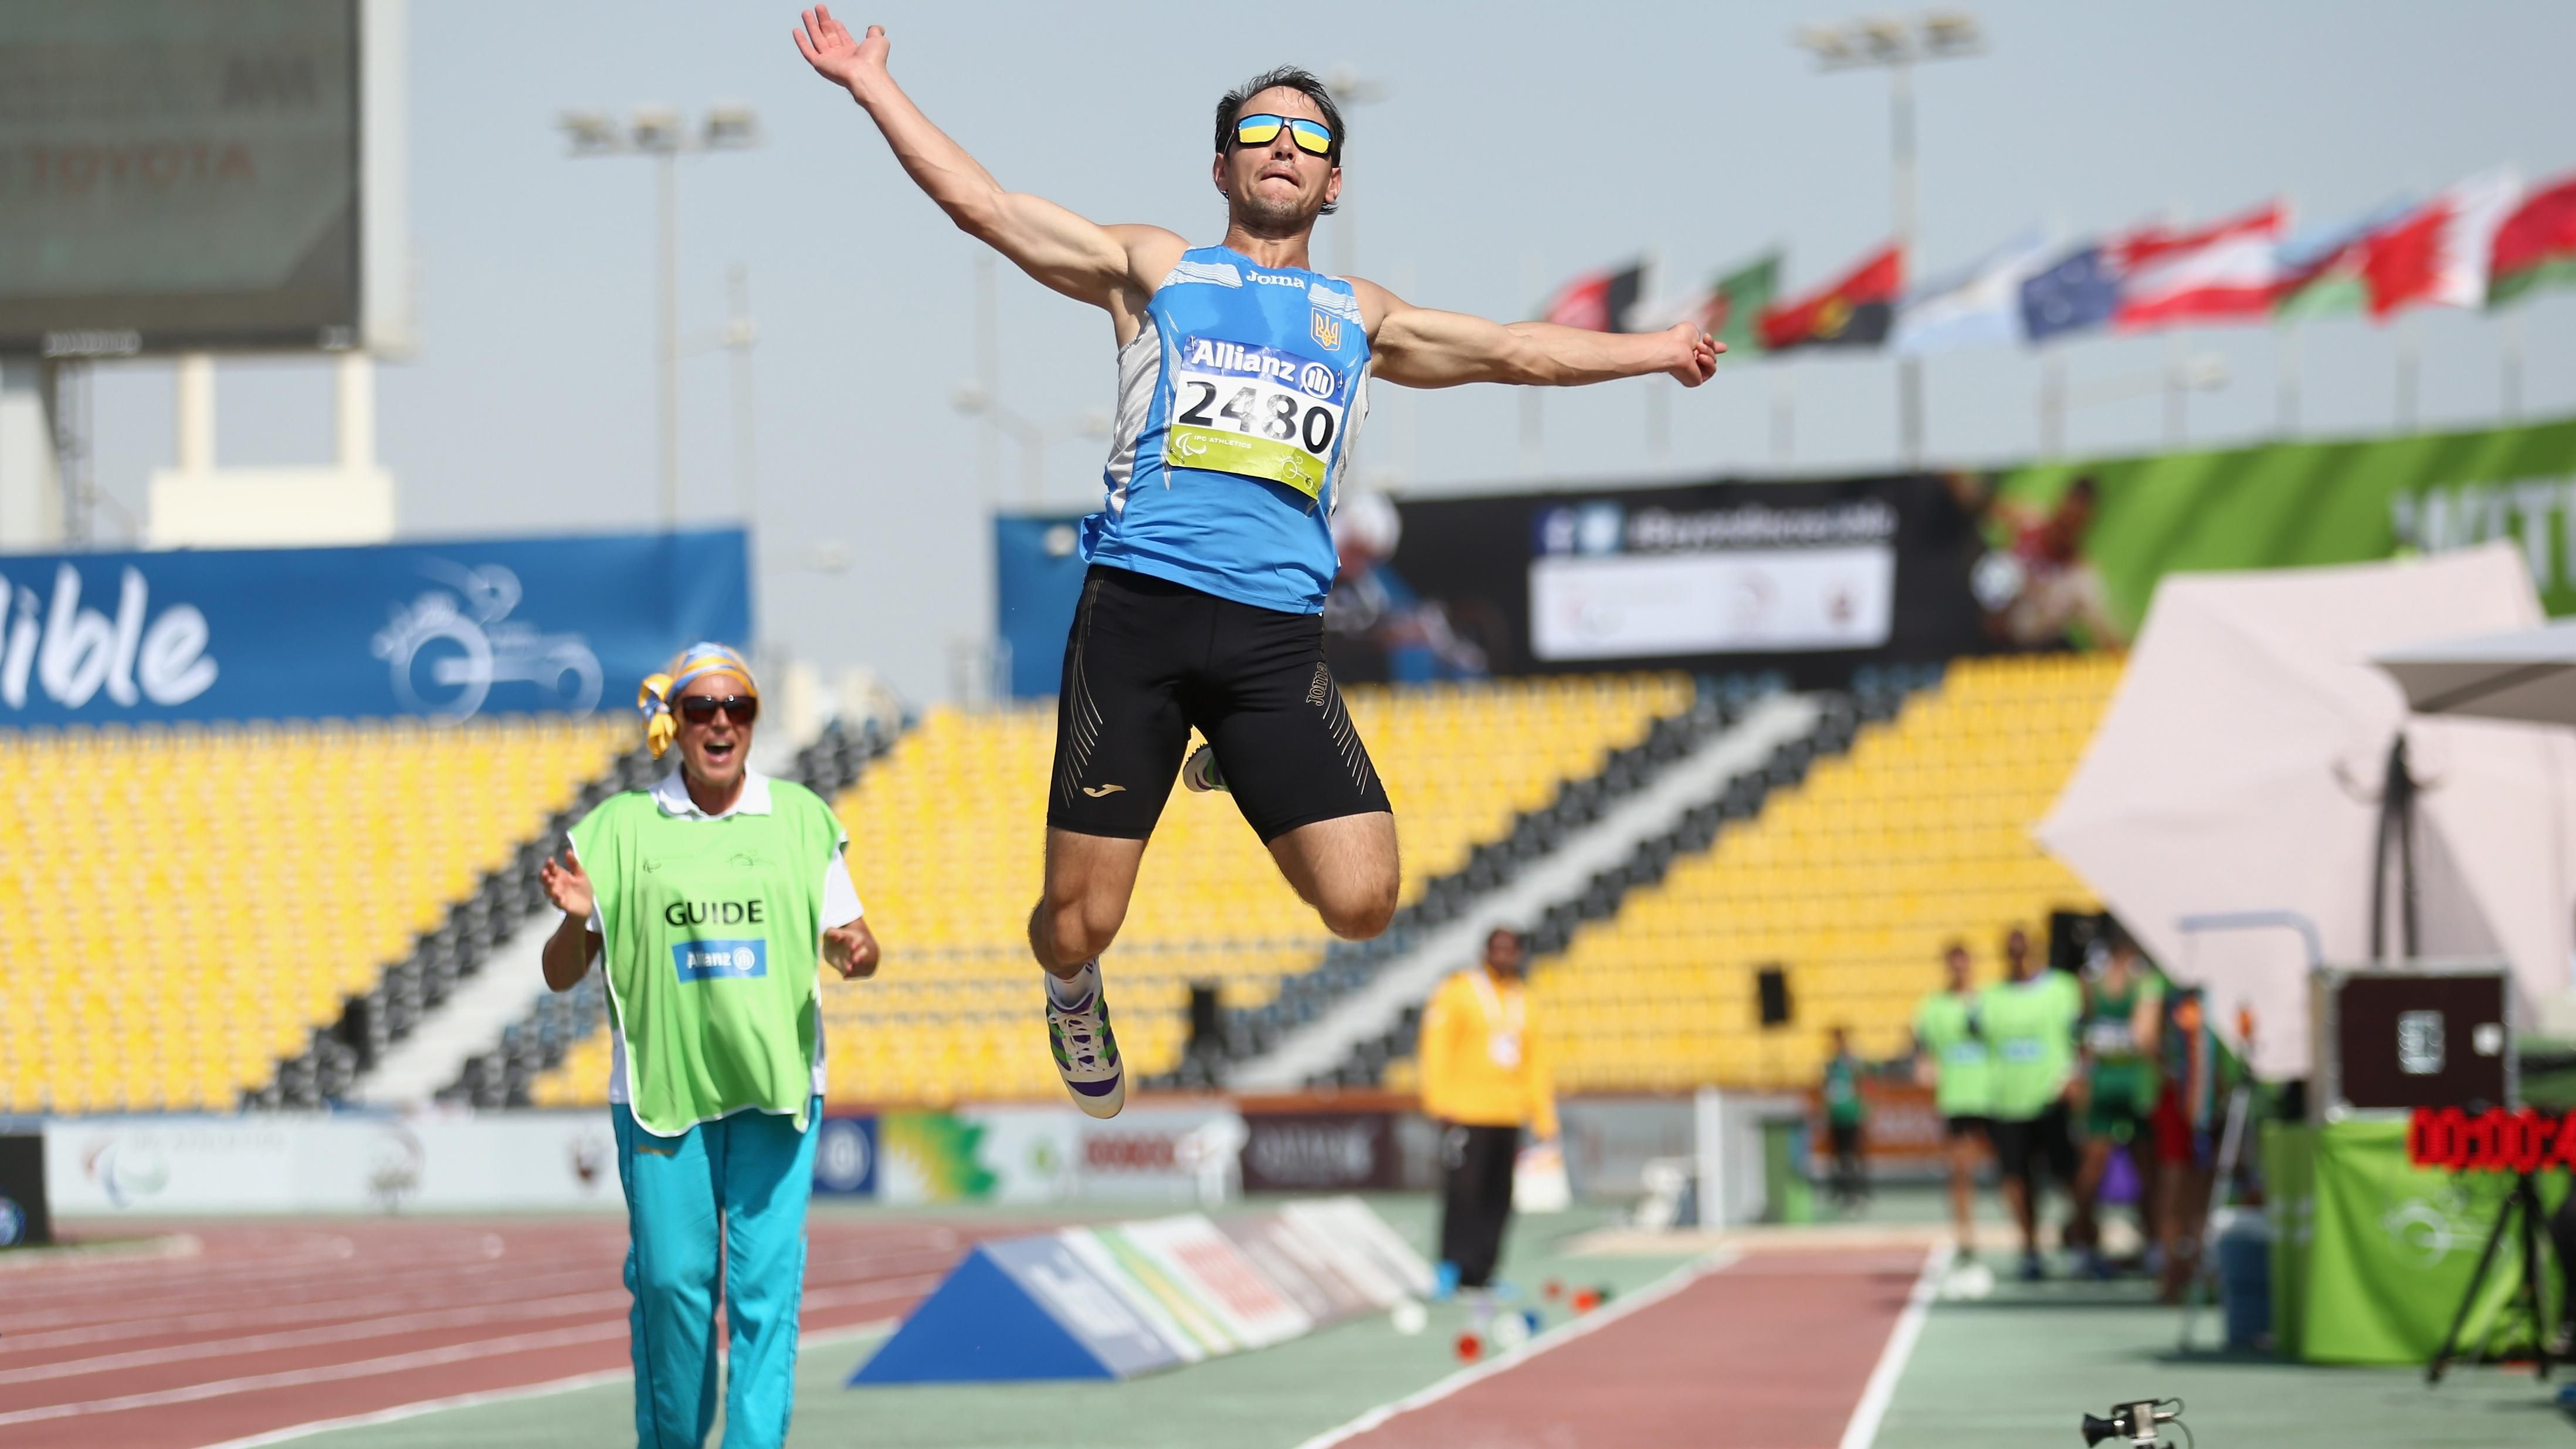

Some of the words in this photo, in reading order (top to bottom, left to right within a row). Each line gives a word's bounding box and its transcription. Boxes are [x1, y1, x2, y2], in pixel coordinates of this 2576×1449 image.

[1246, 270, 1306, 290] Joma
[1191, 339, 1296, 382] Allianz
[1178, 381, 1334, 455] 2480
[1209, 437, 1252, 449] ATHLETICS
[665, 899, 764, 927] GUIDE
